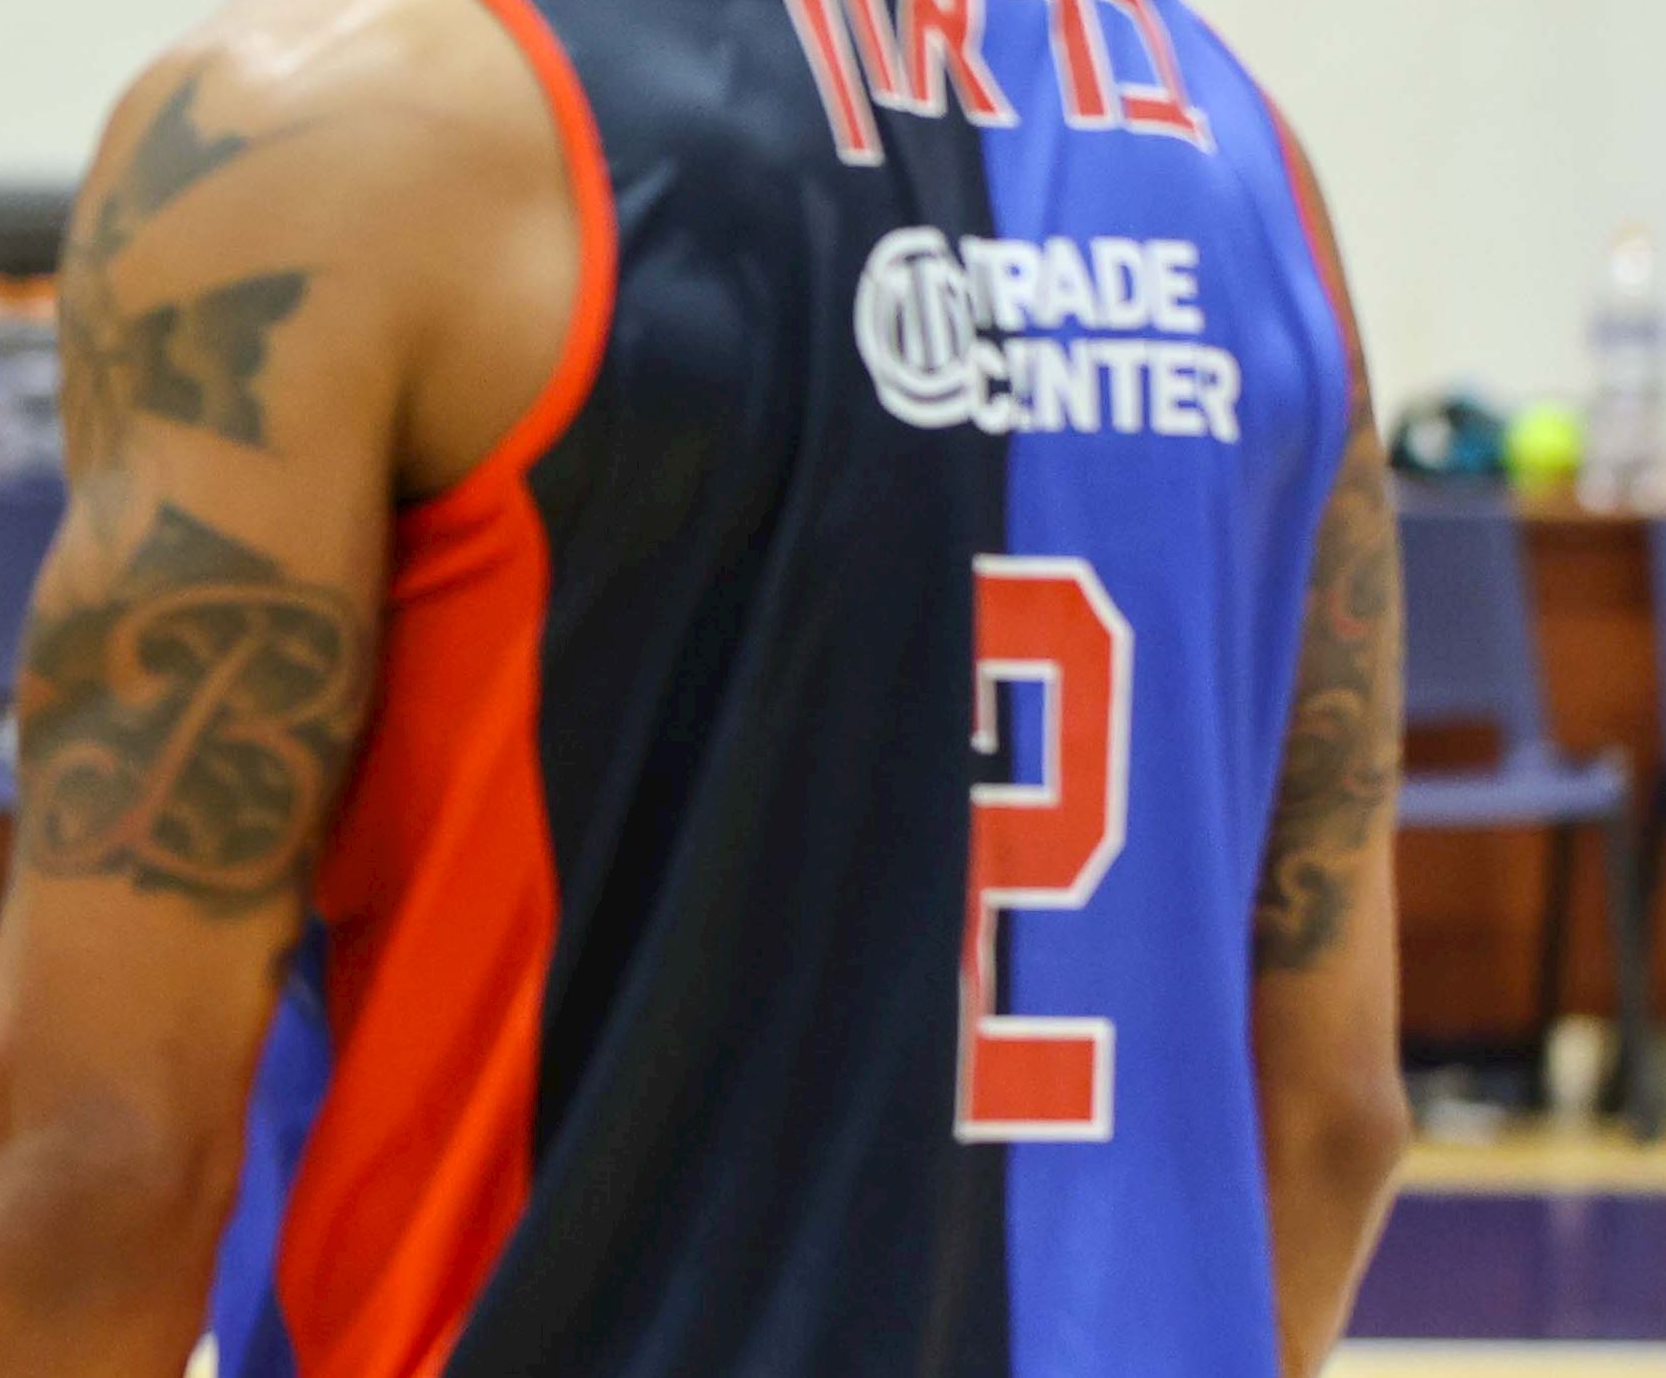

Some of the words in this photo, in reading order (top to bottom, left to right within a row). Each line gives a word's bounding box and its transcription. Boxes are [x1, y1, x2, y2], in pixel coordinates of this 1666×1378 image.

[959, 235, 1206, 333] TRADE
[966, 338, 1241, 444] CENTER
[953, 553, 1134, 1143] 2
